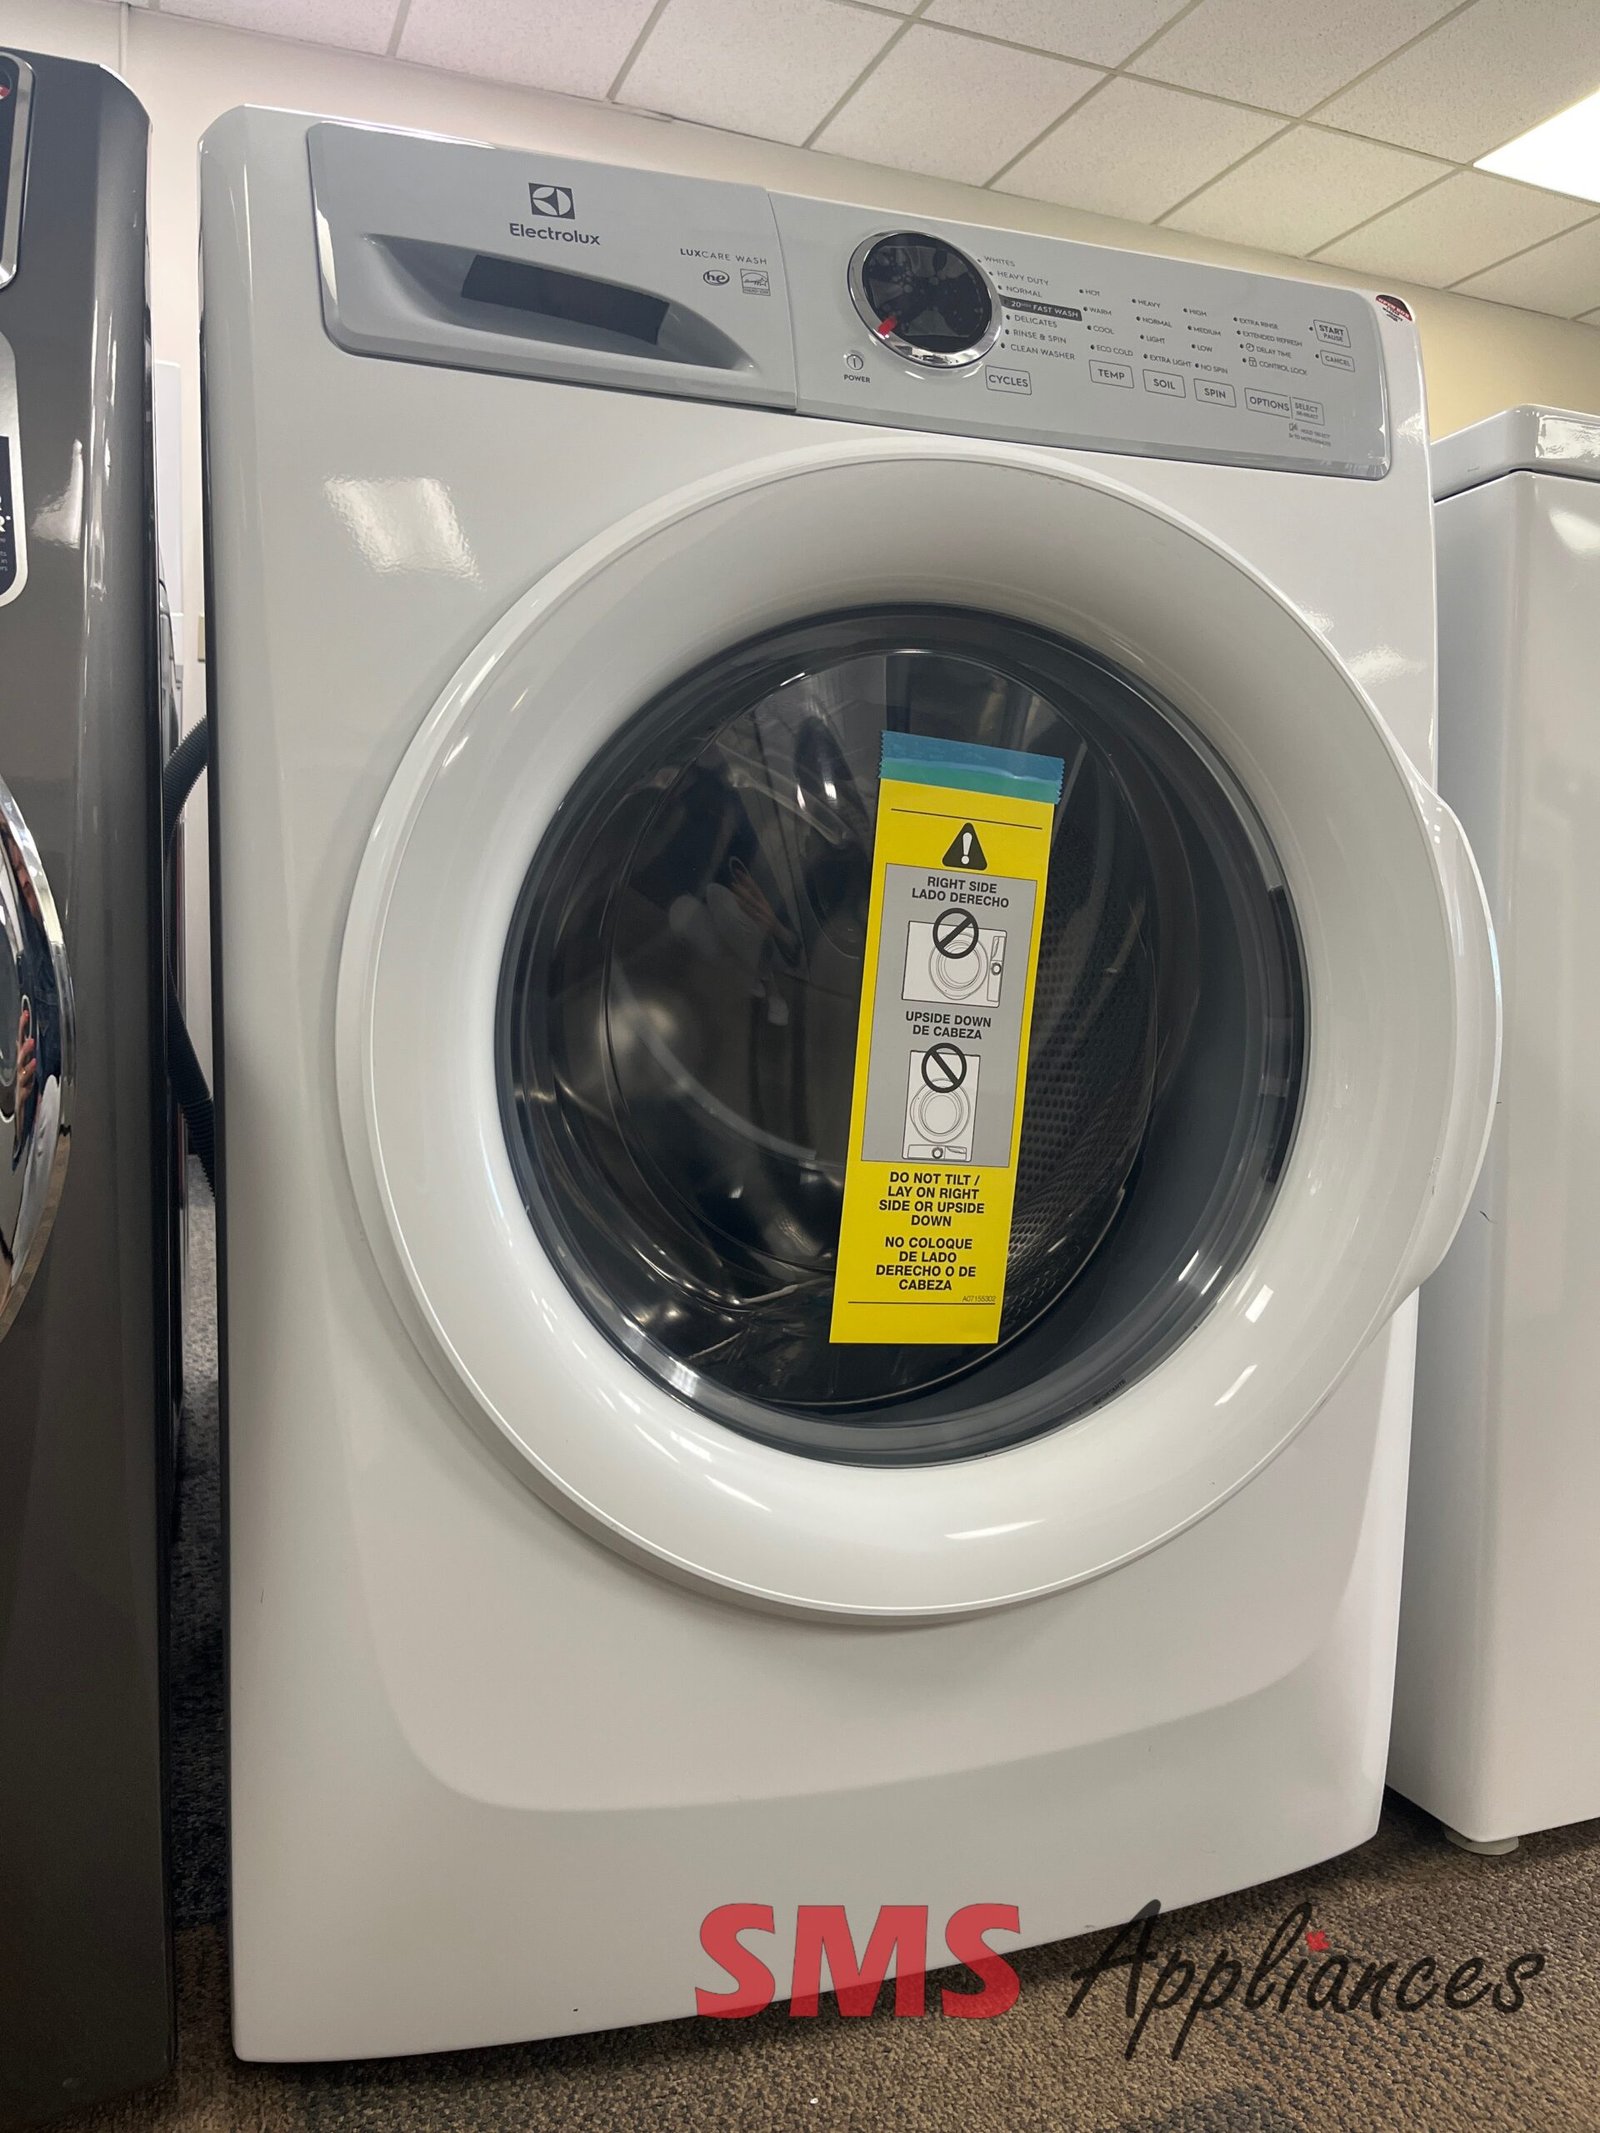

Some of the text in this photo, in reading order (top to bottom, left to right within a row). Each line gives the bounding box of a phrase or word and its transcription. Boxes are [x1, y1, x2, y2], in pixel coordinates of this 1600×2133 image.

[509, 223, 600, 245] Electrolux
[680, 248, 767, 265] LUXCARE WASH
[984, 255, 1015, 267] WHITES
[997, 271, 1049, 286] HEAVY DUTY
[1006, 285, 1042, 298] NORMAL
[1138, 299, 1160, 308] HEAVY
[1033, 305, 1052, 313] FAST
[1054, 308, 1078, 317] WASH
[1090, 307, 1112, 316] WARM
[1014, 315, 1057, 328] DELICATES
[1142, 317, 1172, 328] NORMAL
[1239, 318, 1259, 327] EXTRA
[1093, 325, 1114, 334] COOL
[1319, 325, 1344, 335] START
[1013, 330, 1038, 340] RINSE
[1048, 335, 1067, 344] SPIN
[1146, 335, 1165, 344] LIGHT
[1011, 344, 1075, 360] CLEAN WASHER
[1096, 345, 1133, 356] ECO COLD
[1257, 346, 1276, 355] DELAY
[1150, 354, 1192, 367] EXTRA LIGHT
[1259, 360, 1289, 372] CONTROL
[1325, 356, 1351, 367] CANCEL
[1098, 369, 1125, 380] TEMP
[1213, 366, 1228, 374] SPIN
[844, 374, 870, 383] POWER
[989, 375, 1028, 387] CYCLES
[1153, 378, 1176, 389] SOIL
[1204, 388, 1226, 399] SPIN
[1250, 396, 1289, 411] OPTIONS
[928, 877, 997, 893] RIGHT SIDE
[912, 888, 1009, 908] LADO DERECHO
[906, 1011, 991, 1027] UPSIDE DOWN
[913, 1025, 982, 1039] DE CABEZA
[890, 1172, 980, 1185] DO NOT TILT /
[888, 1187, 979, 1199] LAY ON RIGHT
[879, 1200, 984, 1213] SIDE OR UPSIDE
[911, 1215, 951, 1226] DOWN
[885, 1237, 972, 1249] NO COLOQUE
[899, 1252, 956, 1263] DE LADO
[876, 1265, 976, 1277] DERECHO O DE
[899, 1280, 952, 1290] CABEZA
